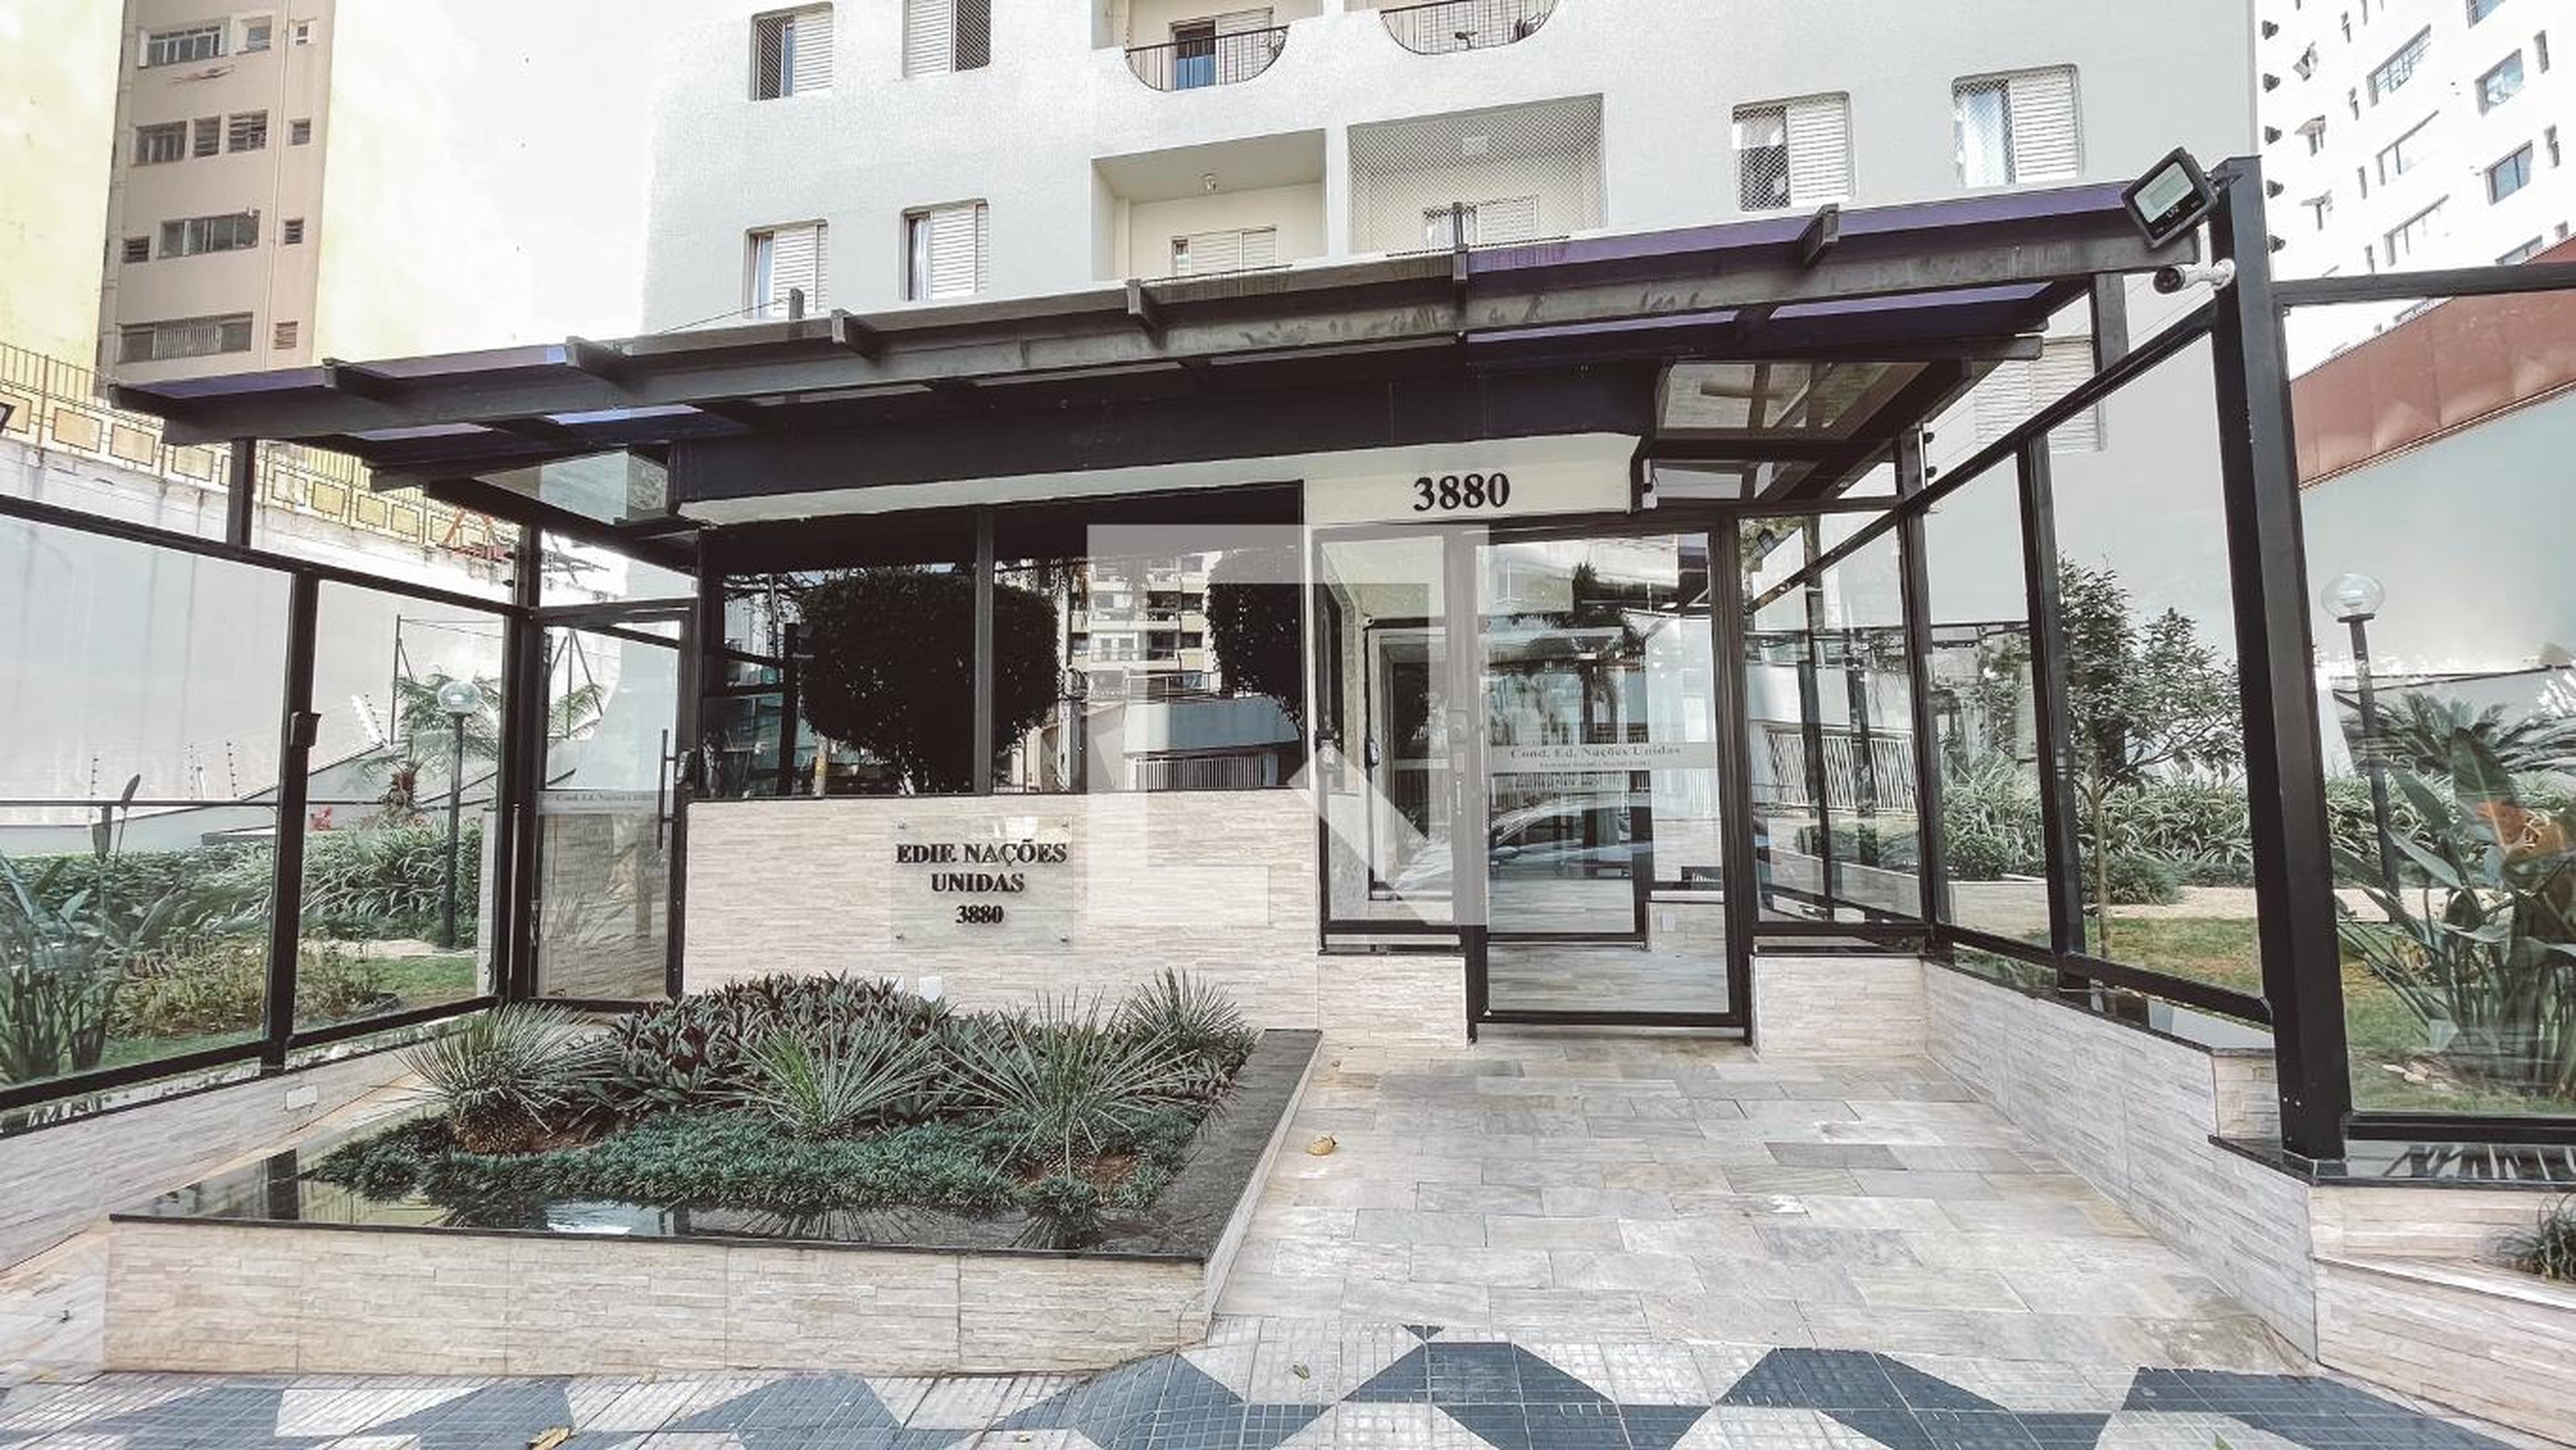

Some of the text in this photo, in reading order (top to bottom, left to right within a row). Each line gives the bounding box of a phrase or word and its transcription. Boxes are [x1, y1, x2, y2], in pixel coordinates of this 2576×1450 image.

[1412, 472, 1511, 511] 3880
[1511, 748, 1550, 758] Cond.
[896, 839, 1068, 867] EDIF. NAÇÕES
[931, 873, 1026, 892] UNIDAS
[955, 904, 1004, 925] 3880
